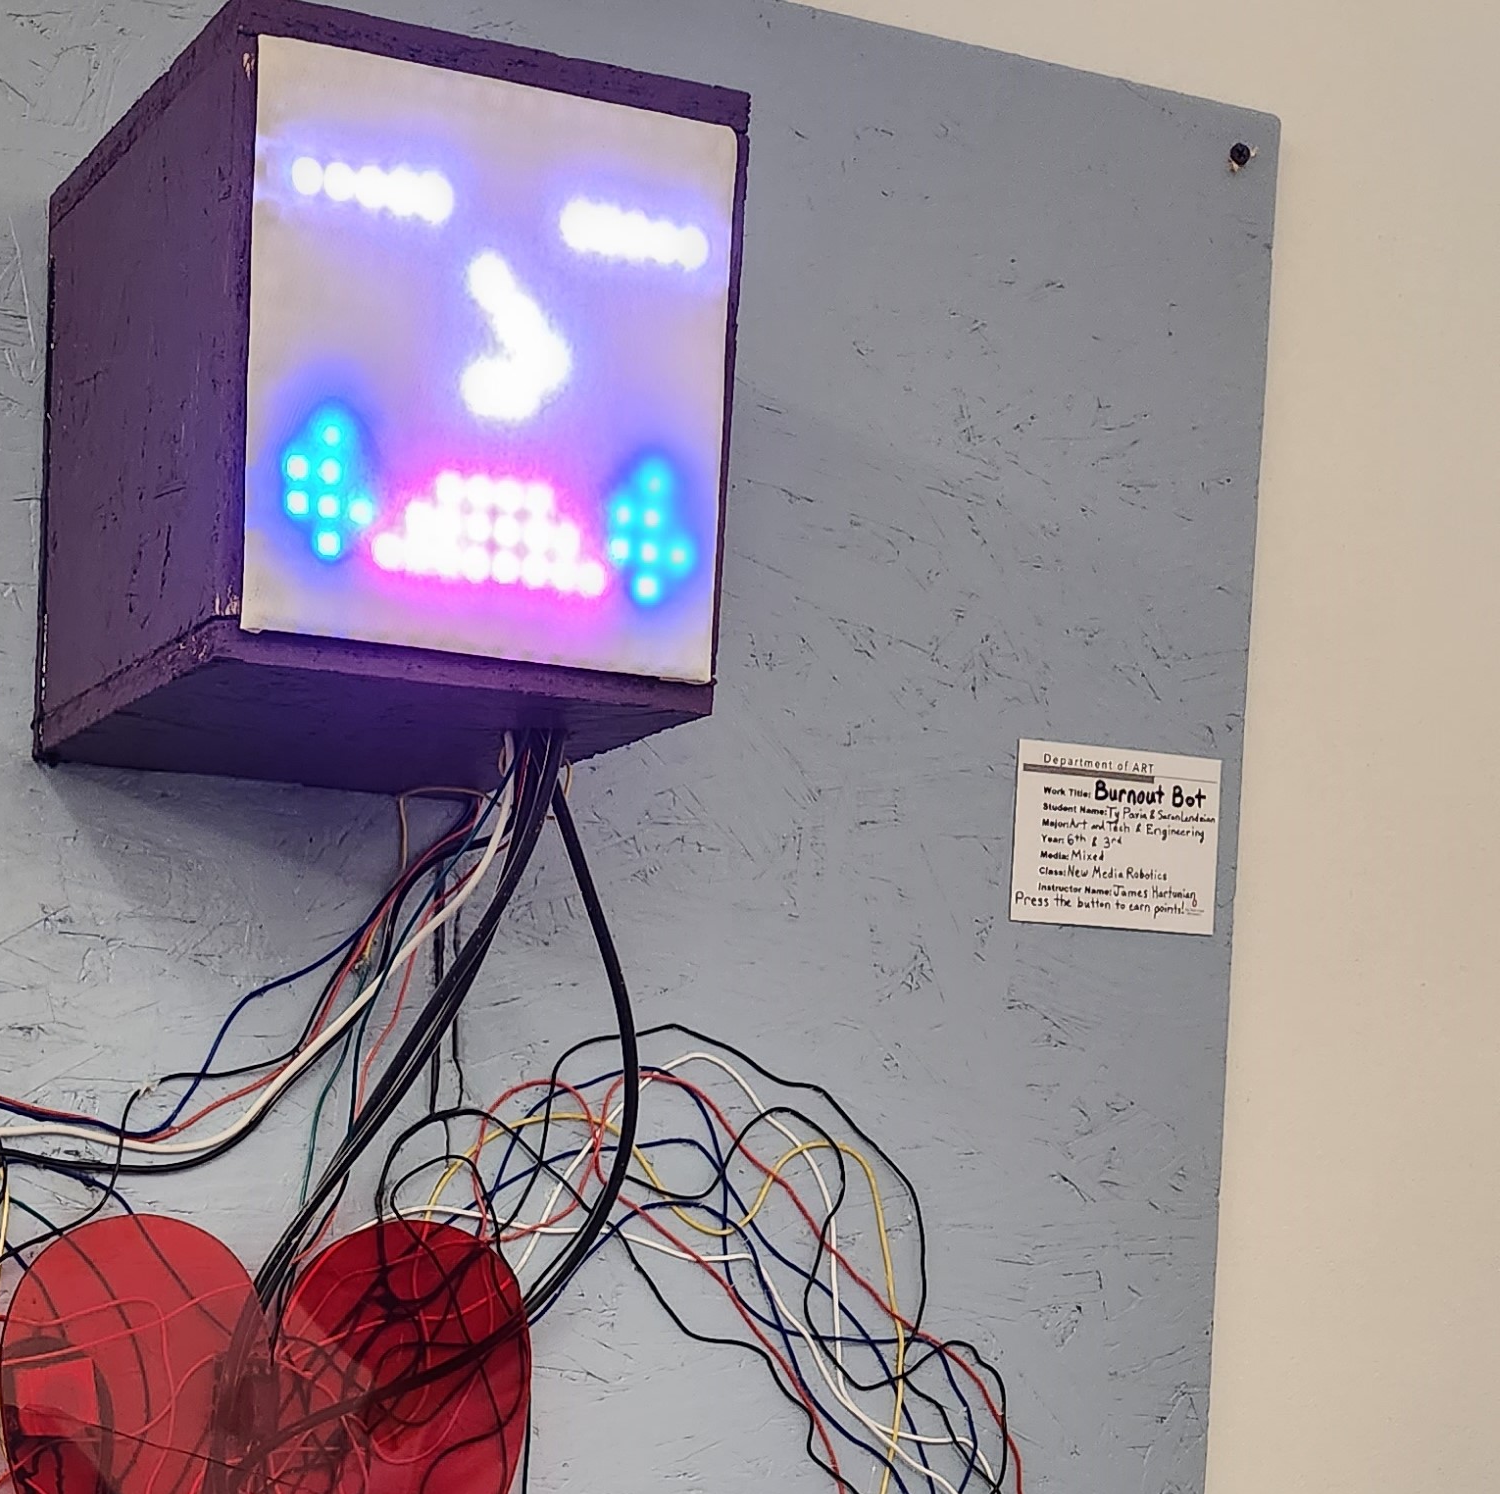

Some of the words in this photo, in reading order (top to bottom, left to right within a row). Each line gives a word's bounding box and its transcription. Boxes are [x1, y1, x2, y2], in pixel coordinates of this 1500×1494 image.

[1044, 753, 1112, 770] Department
[1117, 760, 1128, 770] of
[1132, 762, 1154, 774] ART
[1044, 786, 1066, 796] Work
[1068, 788, 1091, 798] Title:
[1095, 780, 1165, 806] Burnout
[1172, 785, 1206, 808] Bot
[1043, 802, 1076, 813] Student
[1042, 819, 1069, 829] Major:
[1070, 818, 1088, 830] Art
[1091, 820, 1105, 831] and
[1146, 824, 1205, 844] Engineering
[1042, 834, 1064, 844] Year:
[1067, 834, 1086, 846] 6th
[1104, 836, 1122, 848] 3rd
[1040, 850, 1069, 860] Media:
[1071, 850, 1104, 860] Mixed
[1039, 866, 1066, 876] Class:
[1068, 864, 1088, 878] New
[1092, 866, 1123, 878] Media
[1126, 866, 1167, 881] Robotics
[1038, 882, 1082, 893] Instructor
[1084, 886, 1112, 896] Name:
[1113, 884, 1148, 899] James
[1015, 890, 1049, 907] Press
[1054, 894, 1072, 907] the
[1077, 896, 1110, 910] button
[1116, 900, 1125, 910] to
[1129, 904, 1150, 912] earn
[1154, 901, 1184, 919] points!
